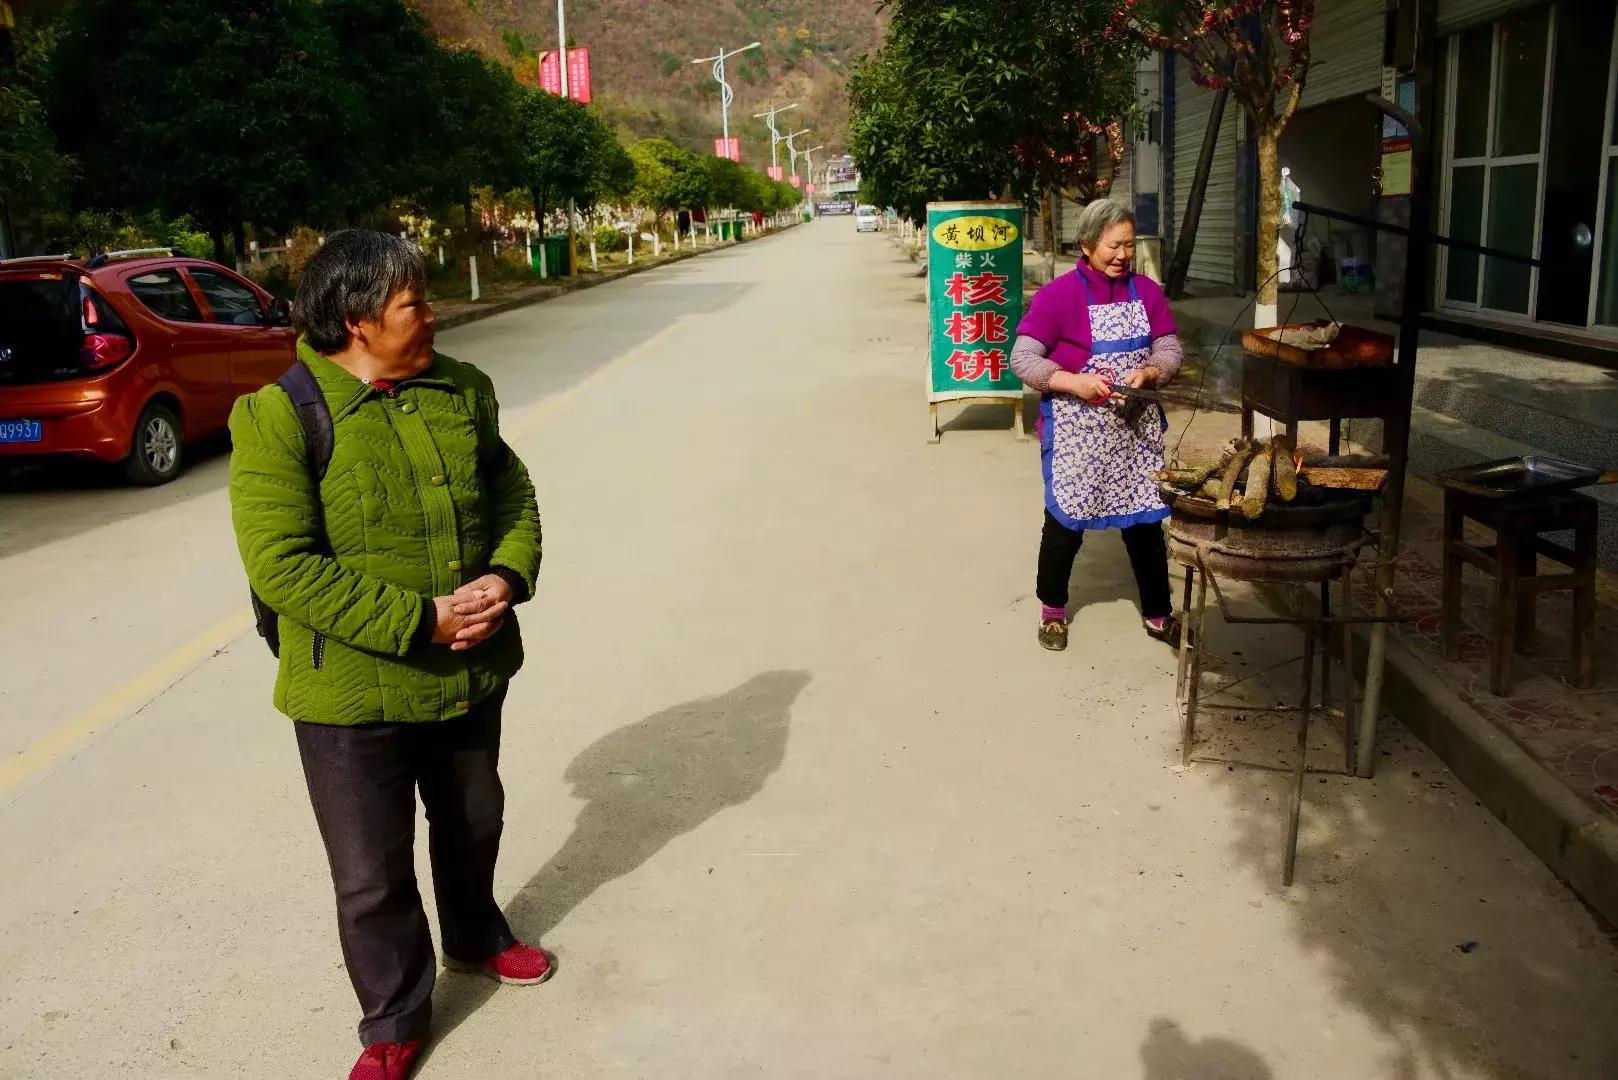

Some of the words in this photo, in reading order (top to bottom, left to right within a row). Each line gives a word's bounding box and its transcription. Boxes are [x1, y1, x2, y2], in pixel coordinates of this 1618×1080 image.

[941, 224, 1010, 244] 黄坝河
[955, 252, 996, 268] 柴火
[945, 272, 1008, 381] 核桃饼
[0, 422, 39, 439] Q9937
